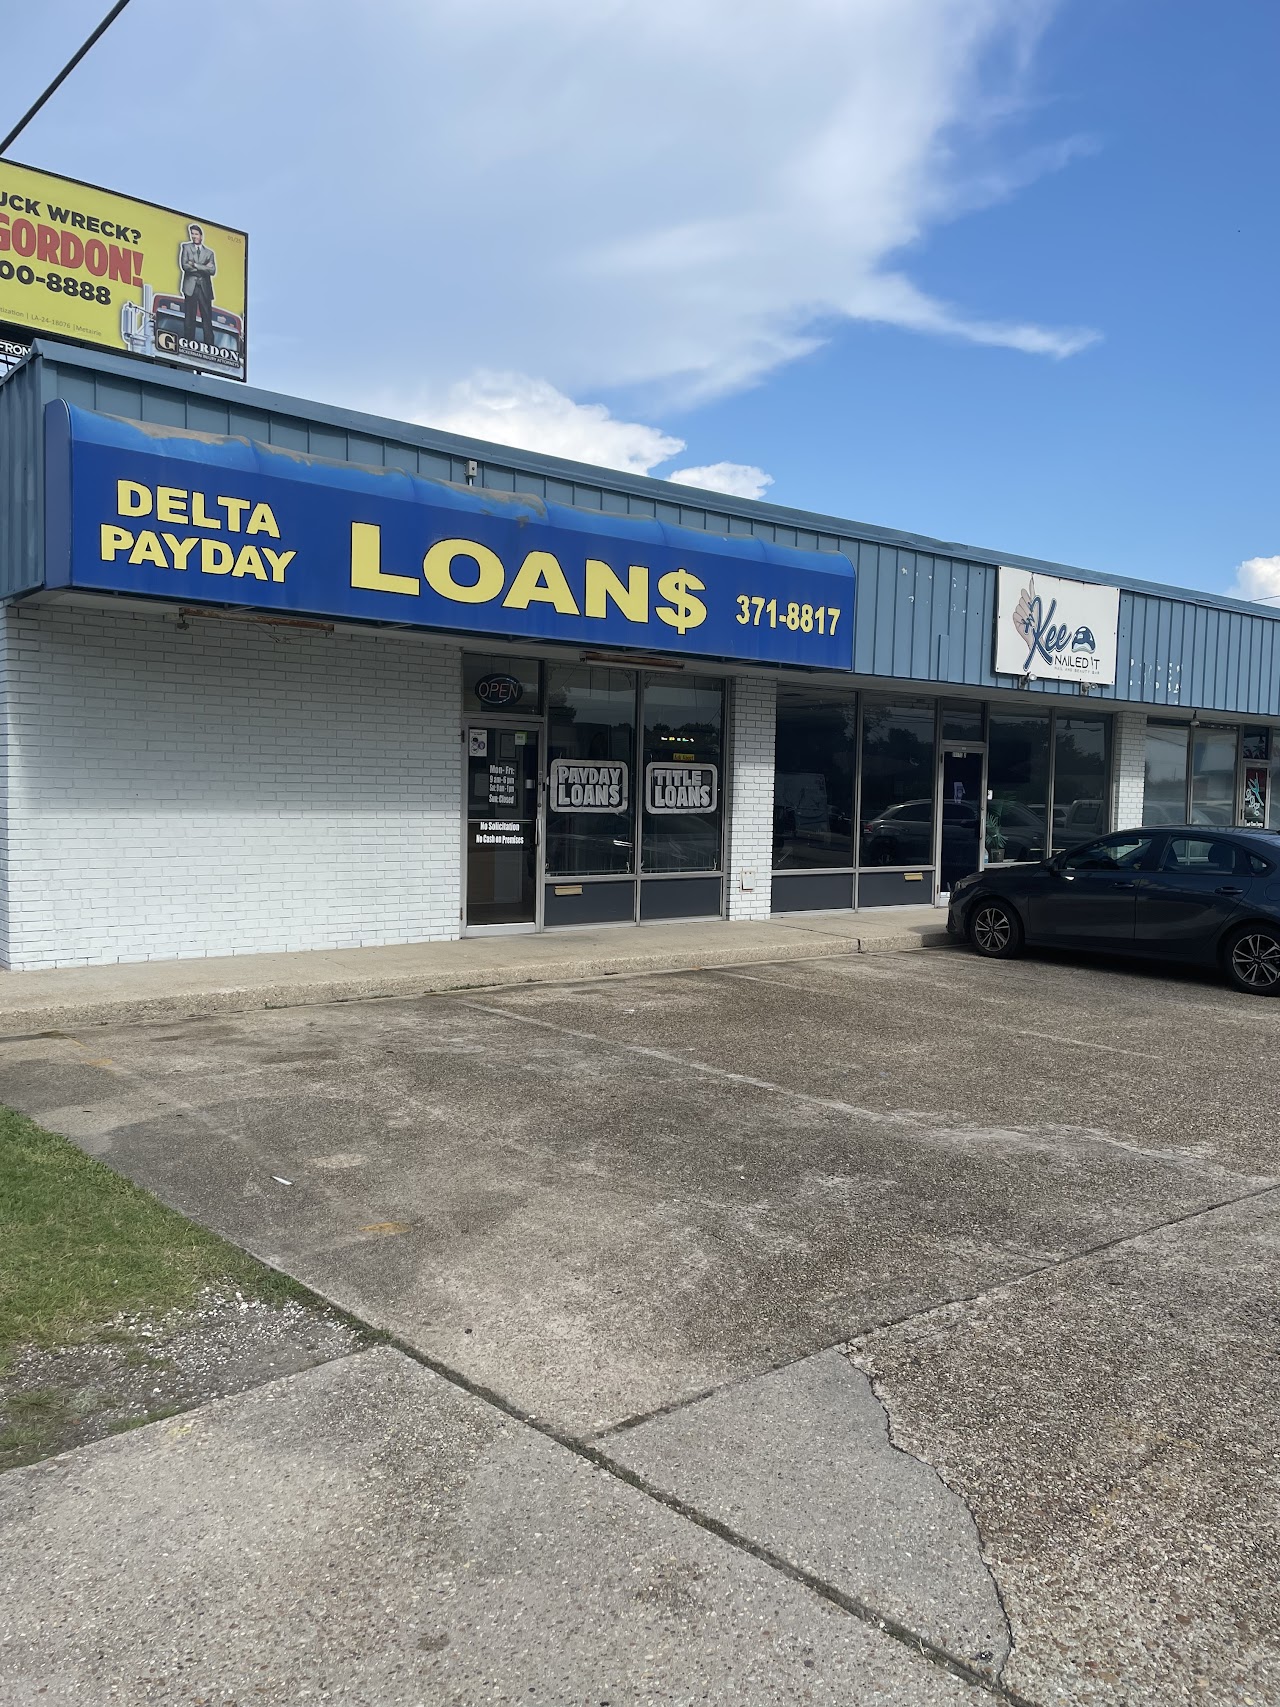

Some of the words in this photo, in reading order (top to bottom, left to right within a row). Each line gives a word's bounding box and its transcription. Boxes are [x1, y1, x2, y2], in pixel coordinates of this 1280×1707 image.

[47, 204, 142, 245] WRECK?
[158, 333, 176, 351] G
[178, 337, 240, 361] GORDON
[117, 479, 281, 538] DELTA
[101, 523, 296, 583] PAYDAY
[350, 521, 708, 636] LOAN$
[735, 594, 841, 636] 371-8817
[1054, 655, 1089, 669] NAILED
[478, 682, 519, 699] OPEN
[557, 766, 622, 785] PAYDAY
[653, 769, 702, 787] TITLE
[499, 794, 515, 804] Closed
[557, 783, 621, 806] LOANS
[654, 785, 710, 807] LOANS
[480, 821, 488, 831] No
[488, 821, 520, 831] Solicitation
[475, 834, 483, 844] No
[483, 834, 496, 844] Cash
[495, 835, 502, 844] on
[502, 835, 525, 845] Premises
